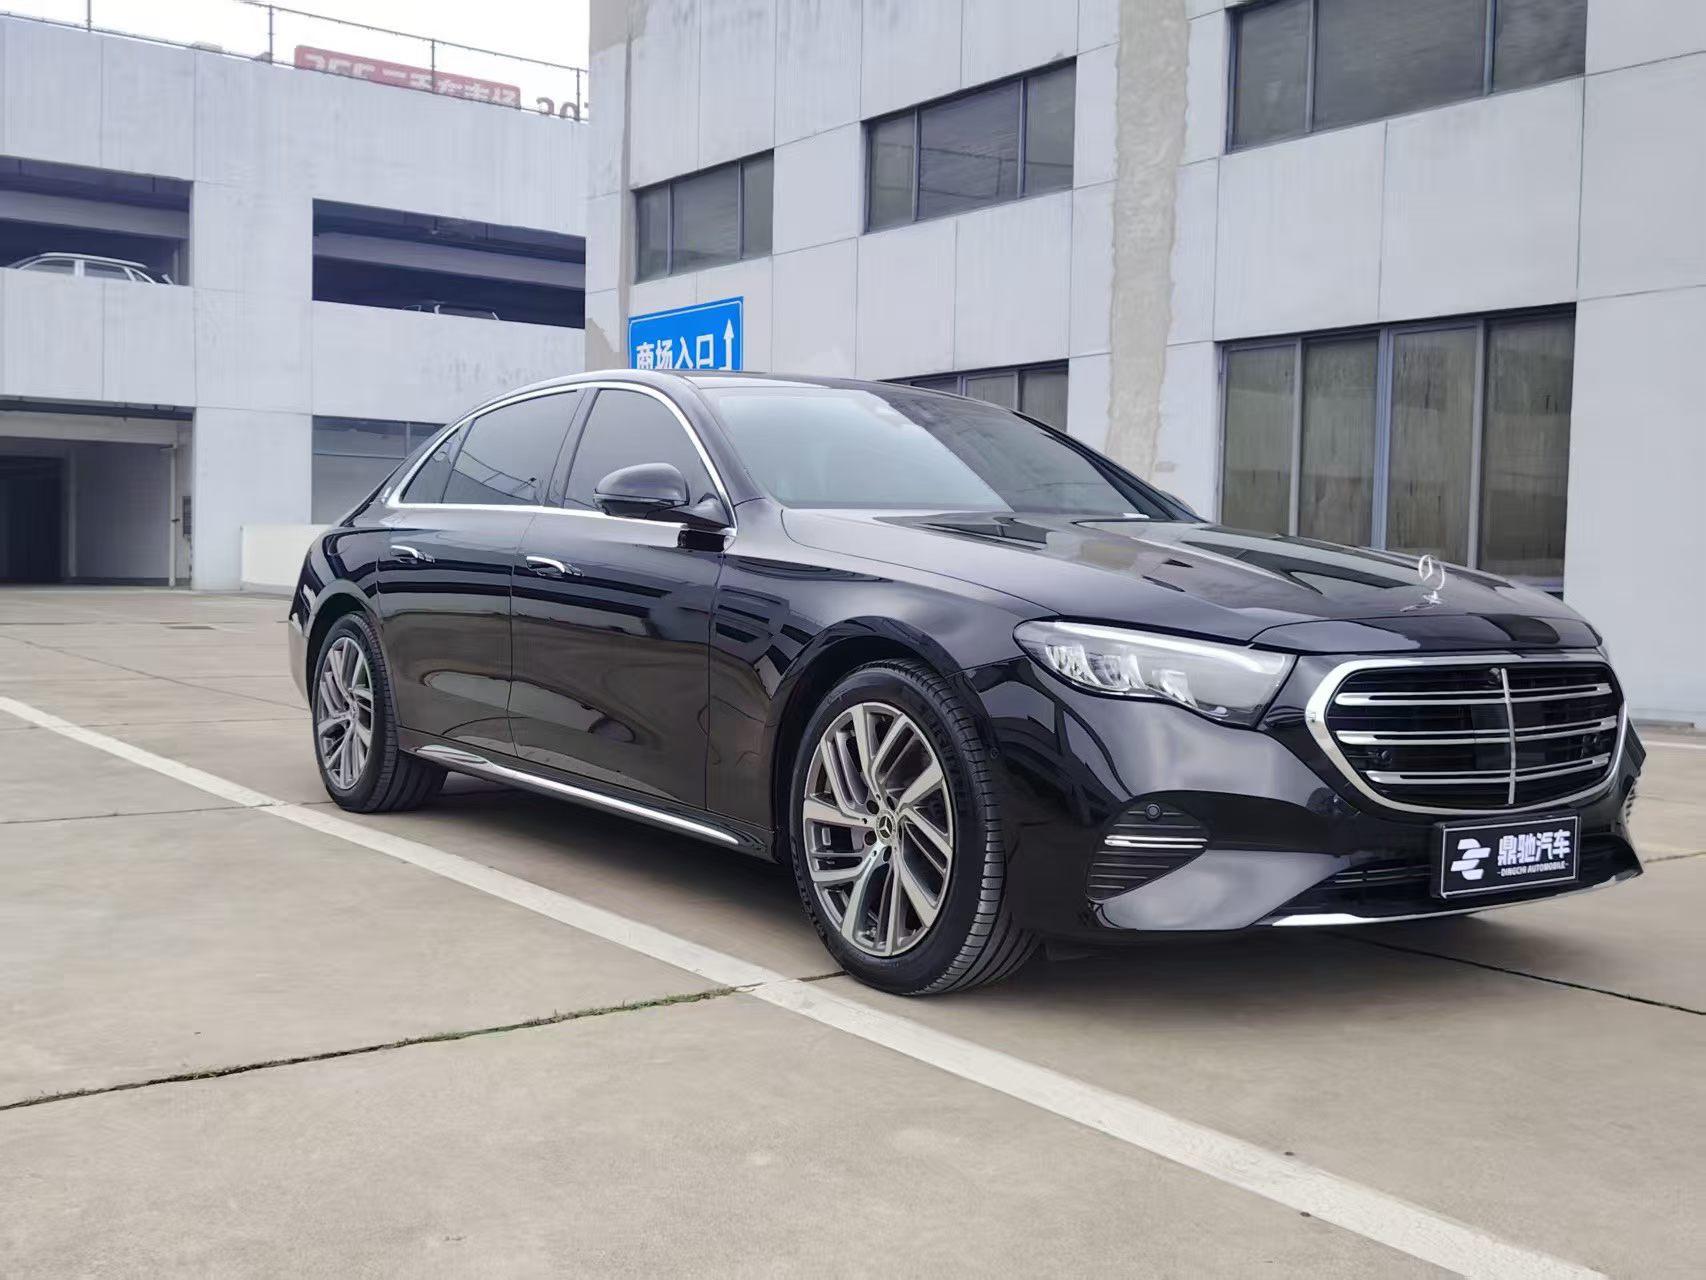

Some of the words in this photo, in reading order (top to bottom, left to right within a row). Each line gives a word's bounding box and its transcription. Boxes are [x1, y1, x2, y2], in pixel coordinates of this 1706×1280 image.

[636, 333, 714, 369] 商场入口
[1497, 829, 1570, 866] 鼎驰汽车
